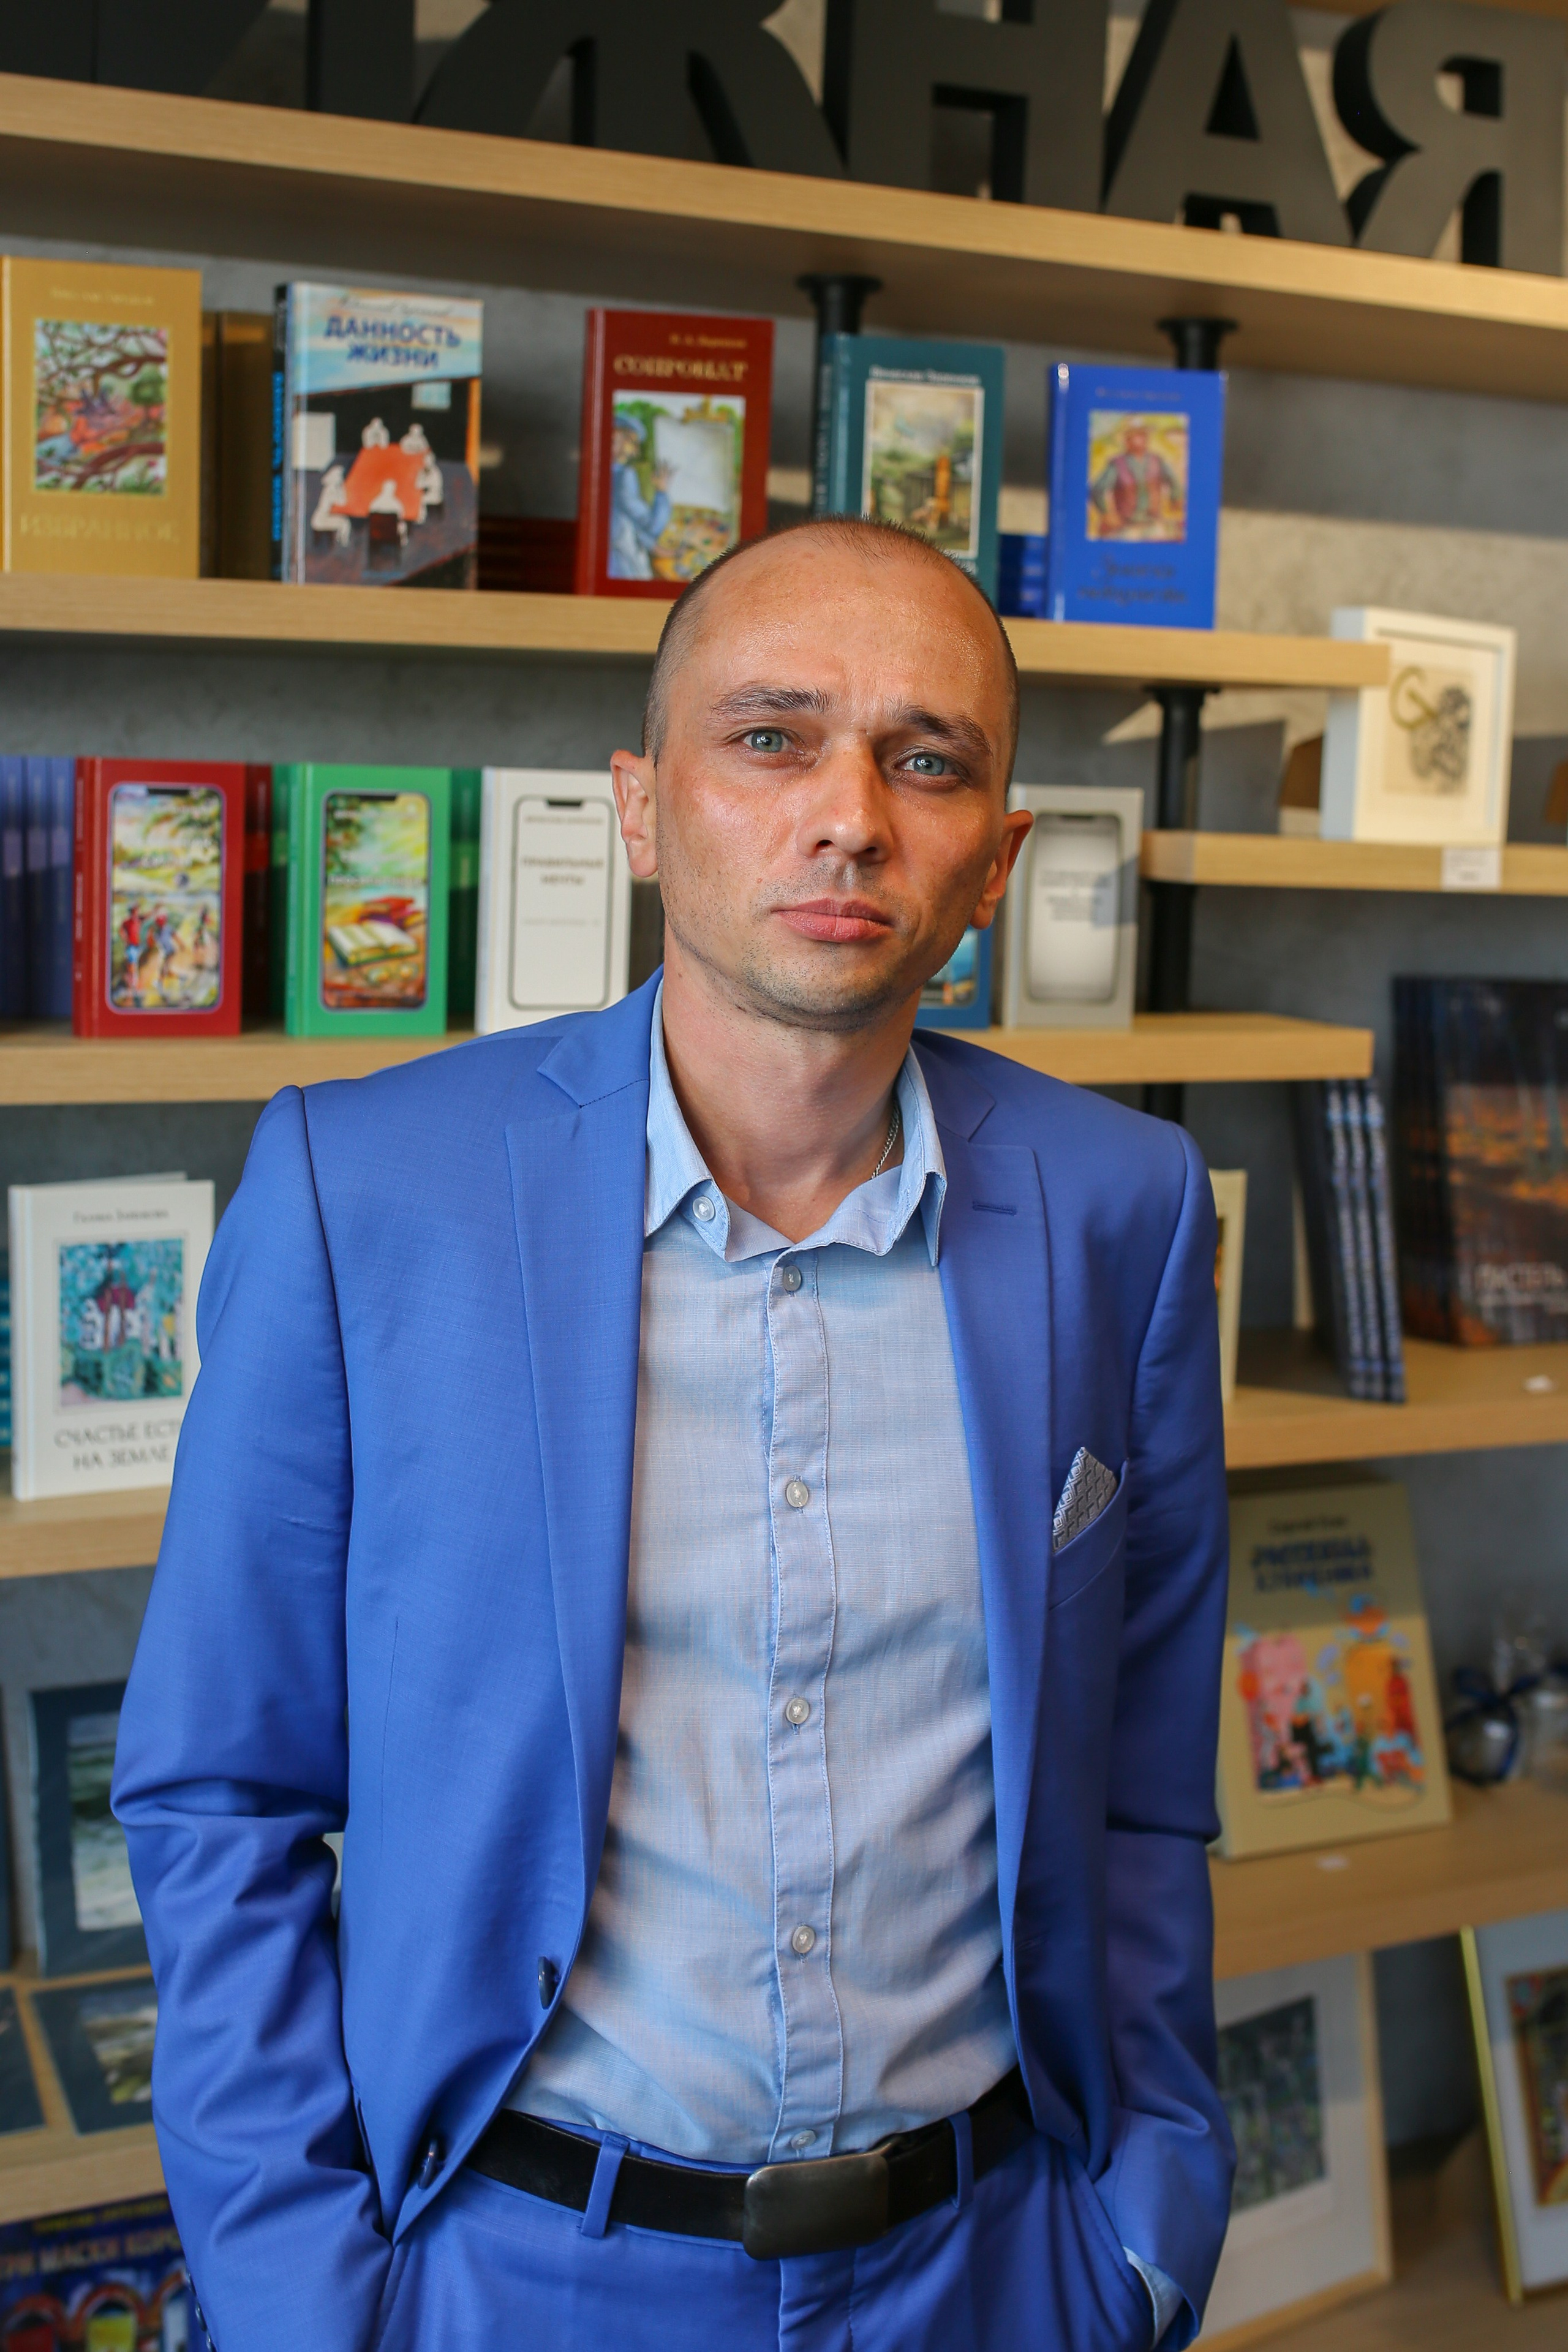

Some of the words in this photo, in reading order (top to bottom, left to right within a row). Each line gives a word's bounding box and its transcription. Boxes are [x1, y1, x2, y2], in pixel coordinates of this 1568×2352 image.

[325, 315, 461, 348] ДАННОСТЬ
[347, 344, 439, 369] ЖИЗНИ
[54, 1420, 138, 1449] СЧАСТЬЕ
[72, 1450, 104, 1469] НА
[109, 1443, 169, 1468] ЗЕМЛЕ
